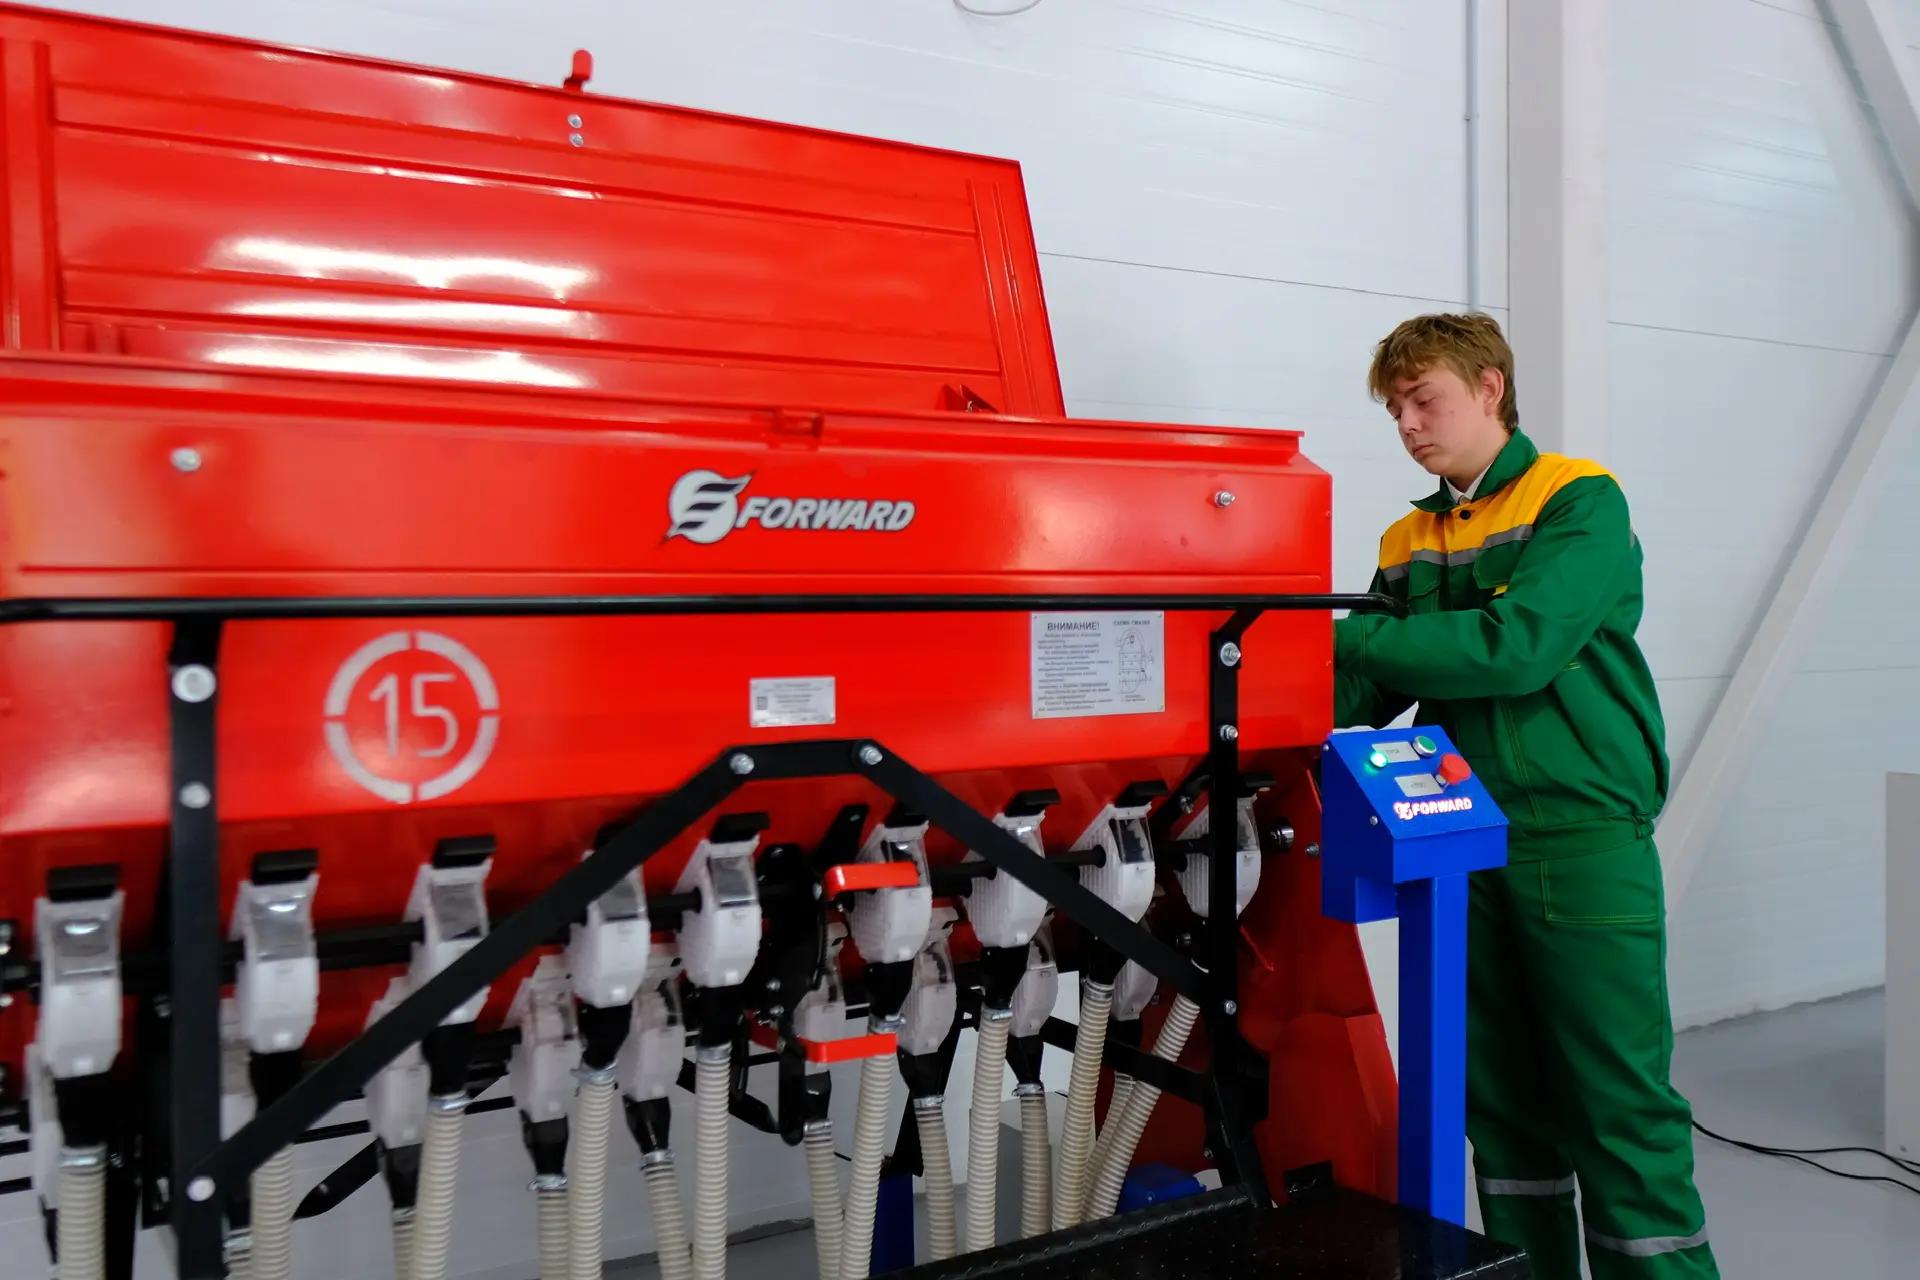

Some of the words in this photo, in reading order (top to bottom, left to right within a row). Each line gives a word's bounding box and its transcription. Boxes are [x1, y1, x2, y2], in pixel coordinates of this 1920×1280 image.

[734, 497, 915, 531] FORWARD
[1047, 621, 1100, 631] ВНИМАНИЕ!
[369, 673, 459, 758] 15
[1411, 797, 1473, 816] FORWARD
